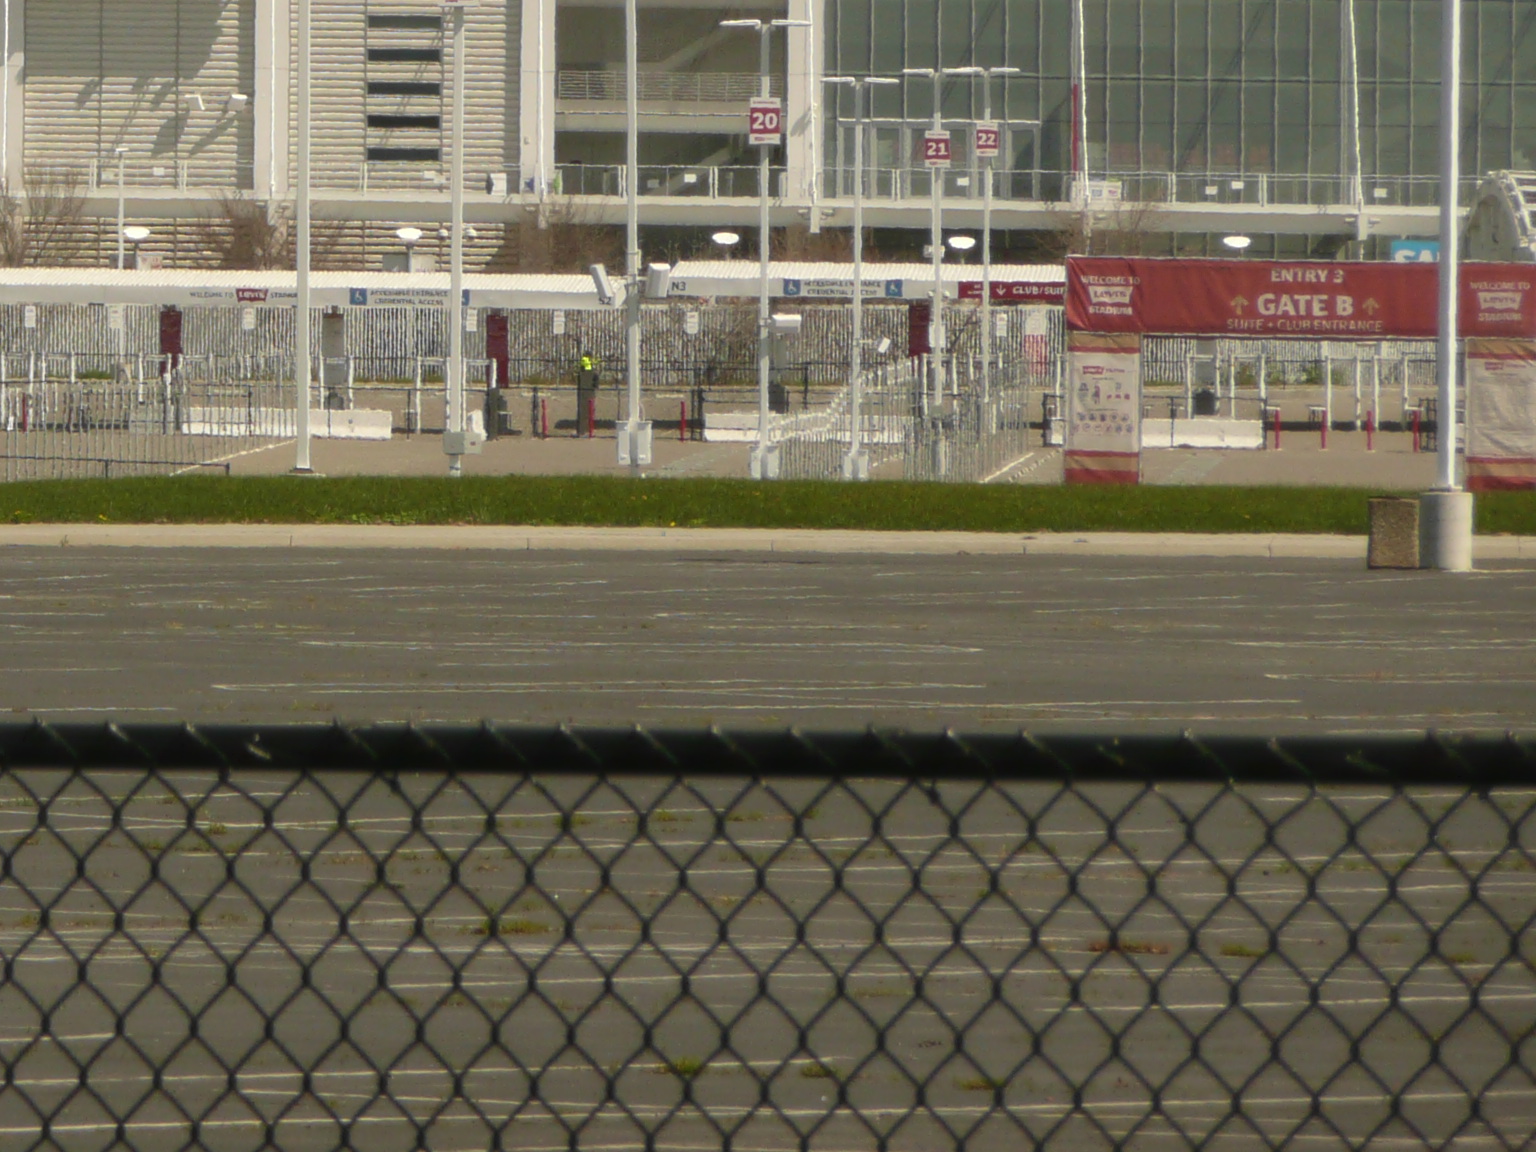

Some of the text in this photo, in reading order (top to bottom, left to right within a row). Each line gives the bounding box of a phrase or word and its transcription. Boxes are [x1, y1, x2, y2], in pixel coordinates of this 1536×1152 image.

[753, 112, 778, 130] 20
[978, 133, 996, 145] 22
[927, 142, 948, 156] 21
[1081, 275, 1140, 284] WELCOME TO
[1271, 268, 1344, 283] ENTRY 3
[671, 281, 686, 291] N3
[1012, 285, 1064, 295] CLUB/SUIT
[1089, 306, 1132, 315] STADIUM
[1257, 293, 1354, 316] GATE B
[1227, 319, 1264, 330] SUITE
[1277, 319, 1311, 330] CLUB
[1313, 320, 1383, 331] ENTRANCE
